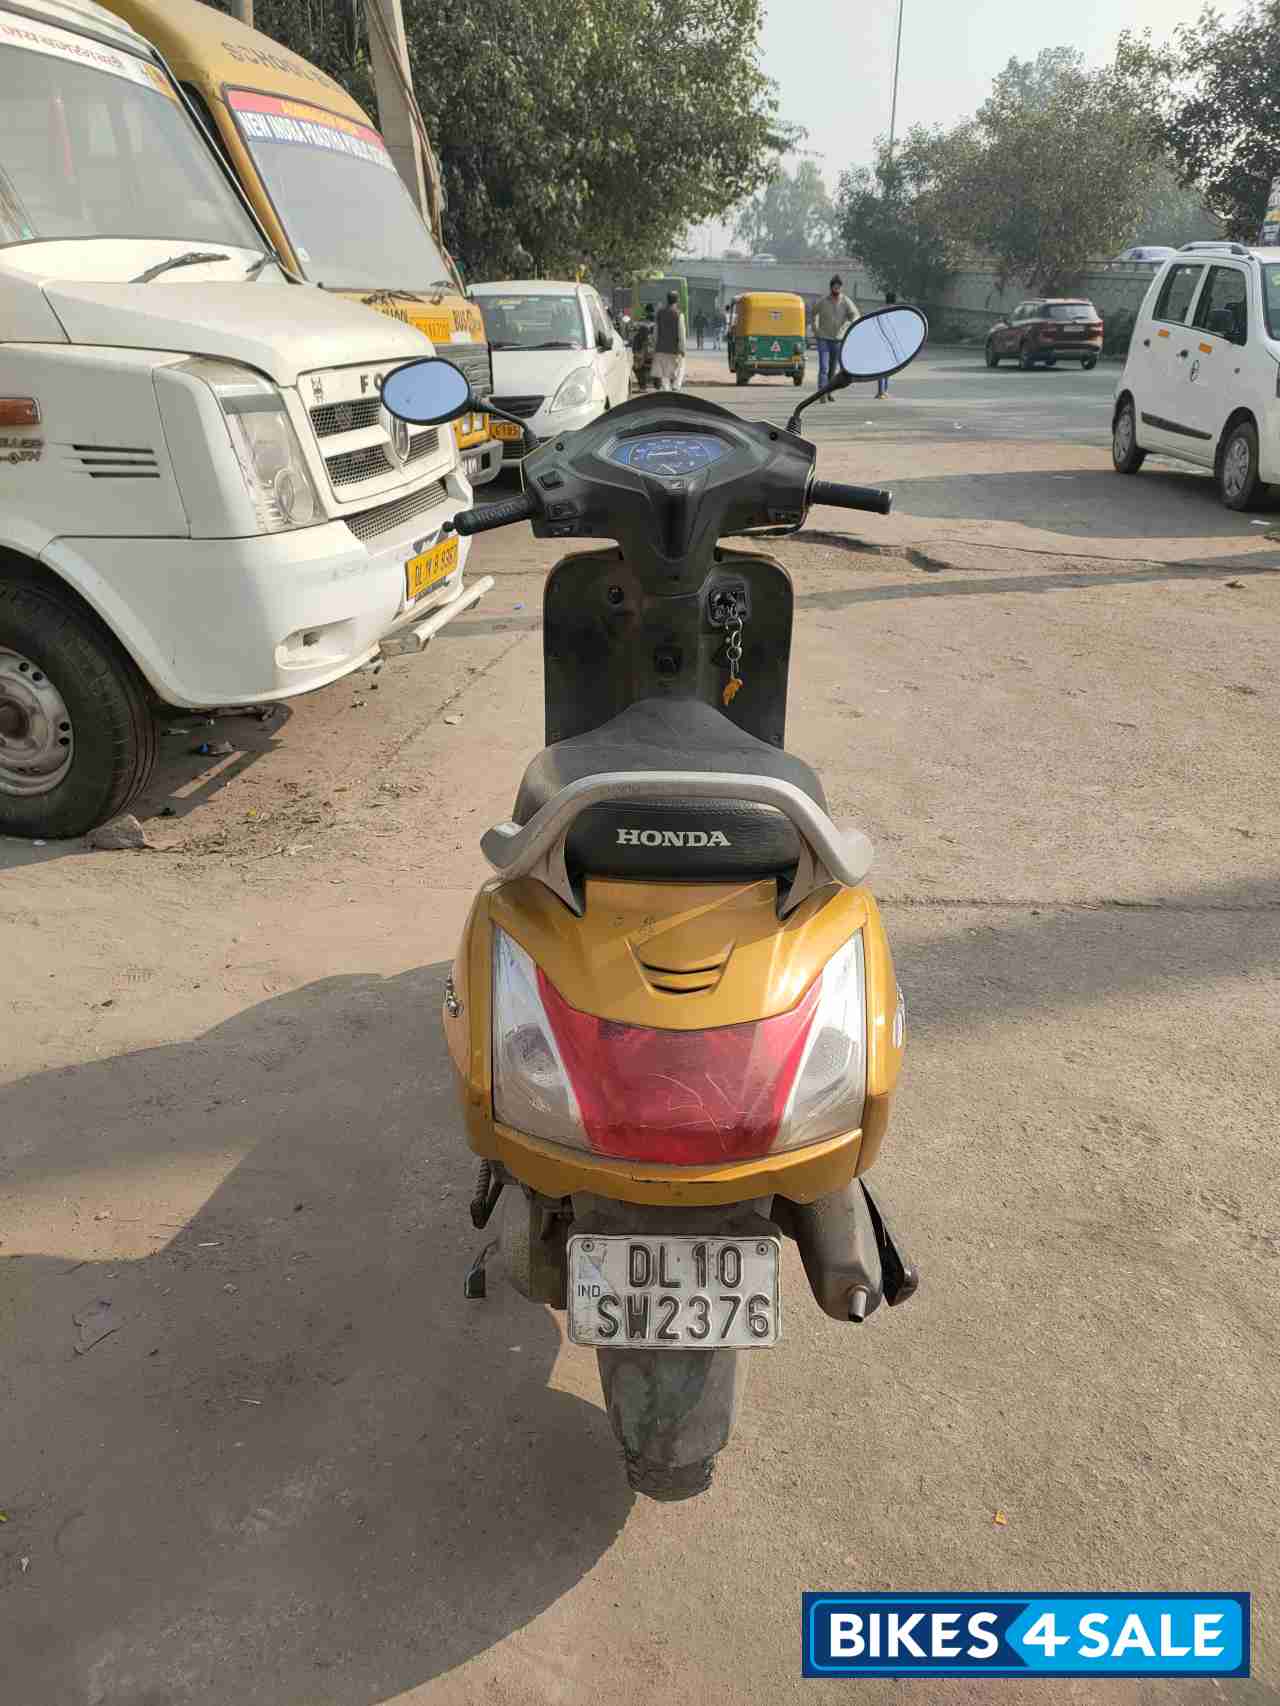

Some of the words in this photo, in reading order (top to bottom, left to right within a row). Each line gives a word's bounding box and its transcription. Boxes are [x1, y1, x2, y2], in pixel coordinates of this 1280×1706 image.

[616, 829, 732, 847] HONDA
[629, 1244, 681, 1289] DL
[692, 1243, 743, 1289] 10
[577, 1285, 601, 1297] IND
